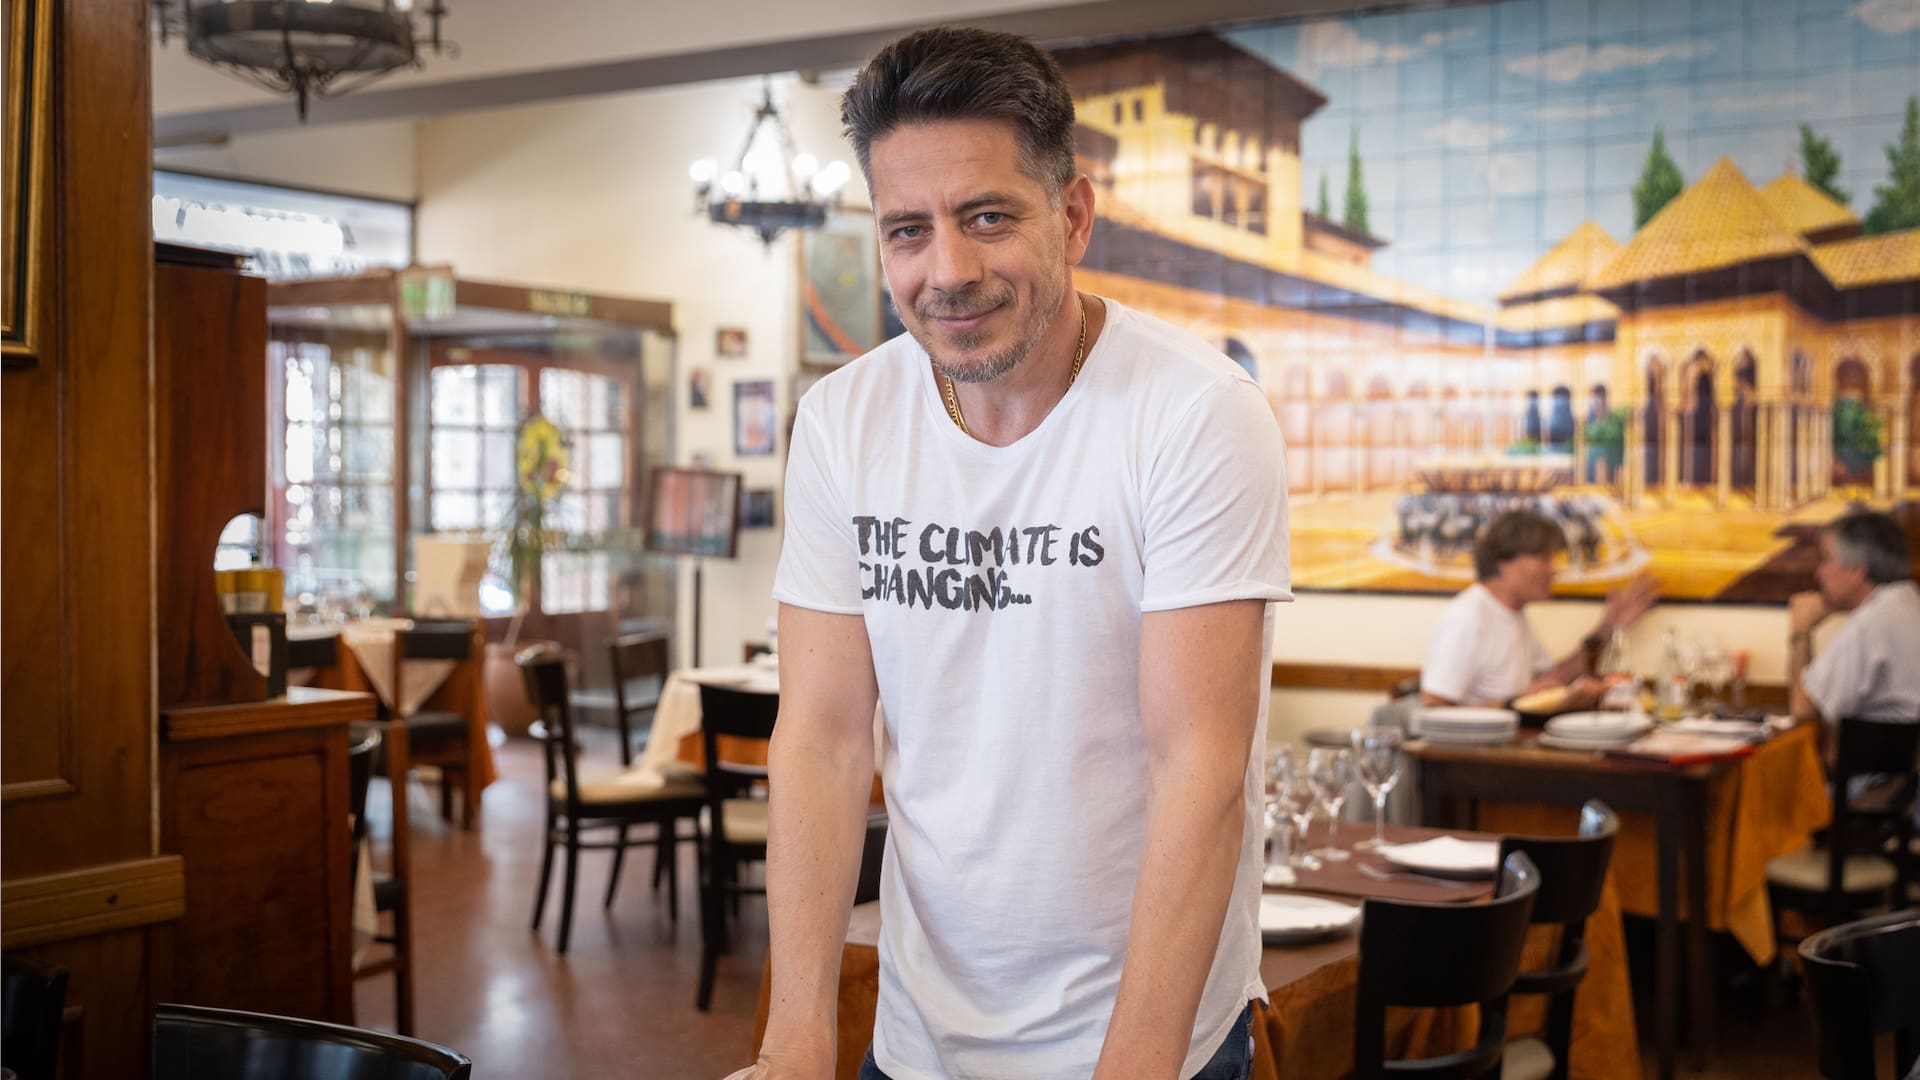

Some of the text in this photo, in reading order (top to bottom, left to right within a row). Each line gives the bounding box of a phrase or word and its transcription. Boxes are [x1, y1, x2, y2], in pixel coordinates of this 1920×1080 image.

[852, 516, 1105, 567] THE CLIMATE IS
[859, 561, 1032, 613] CHANGING...
